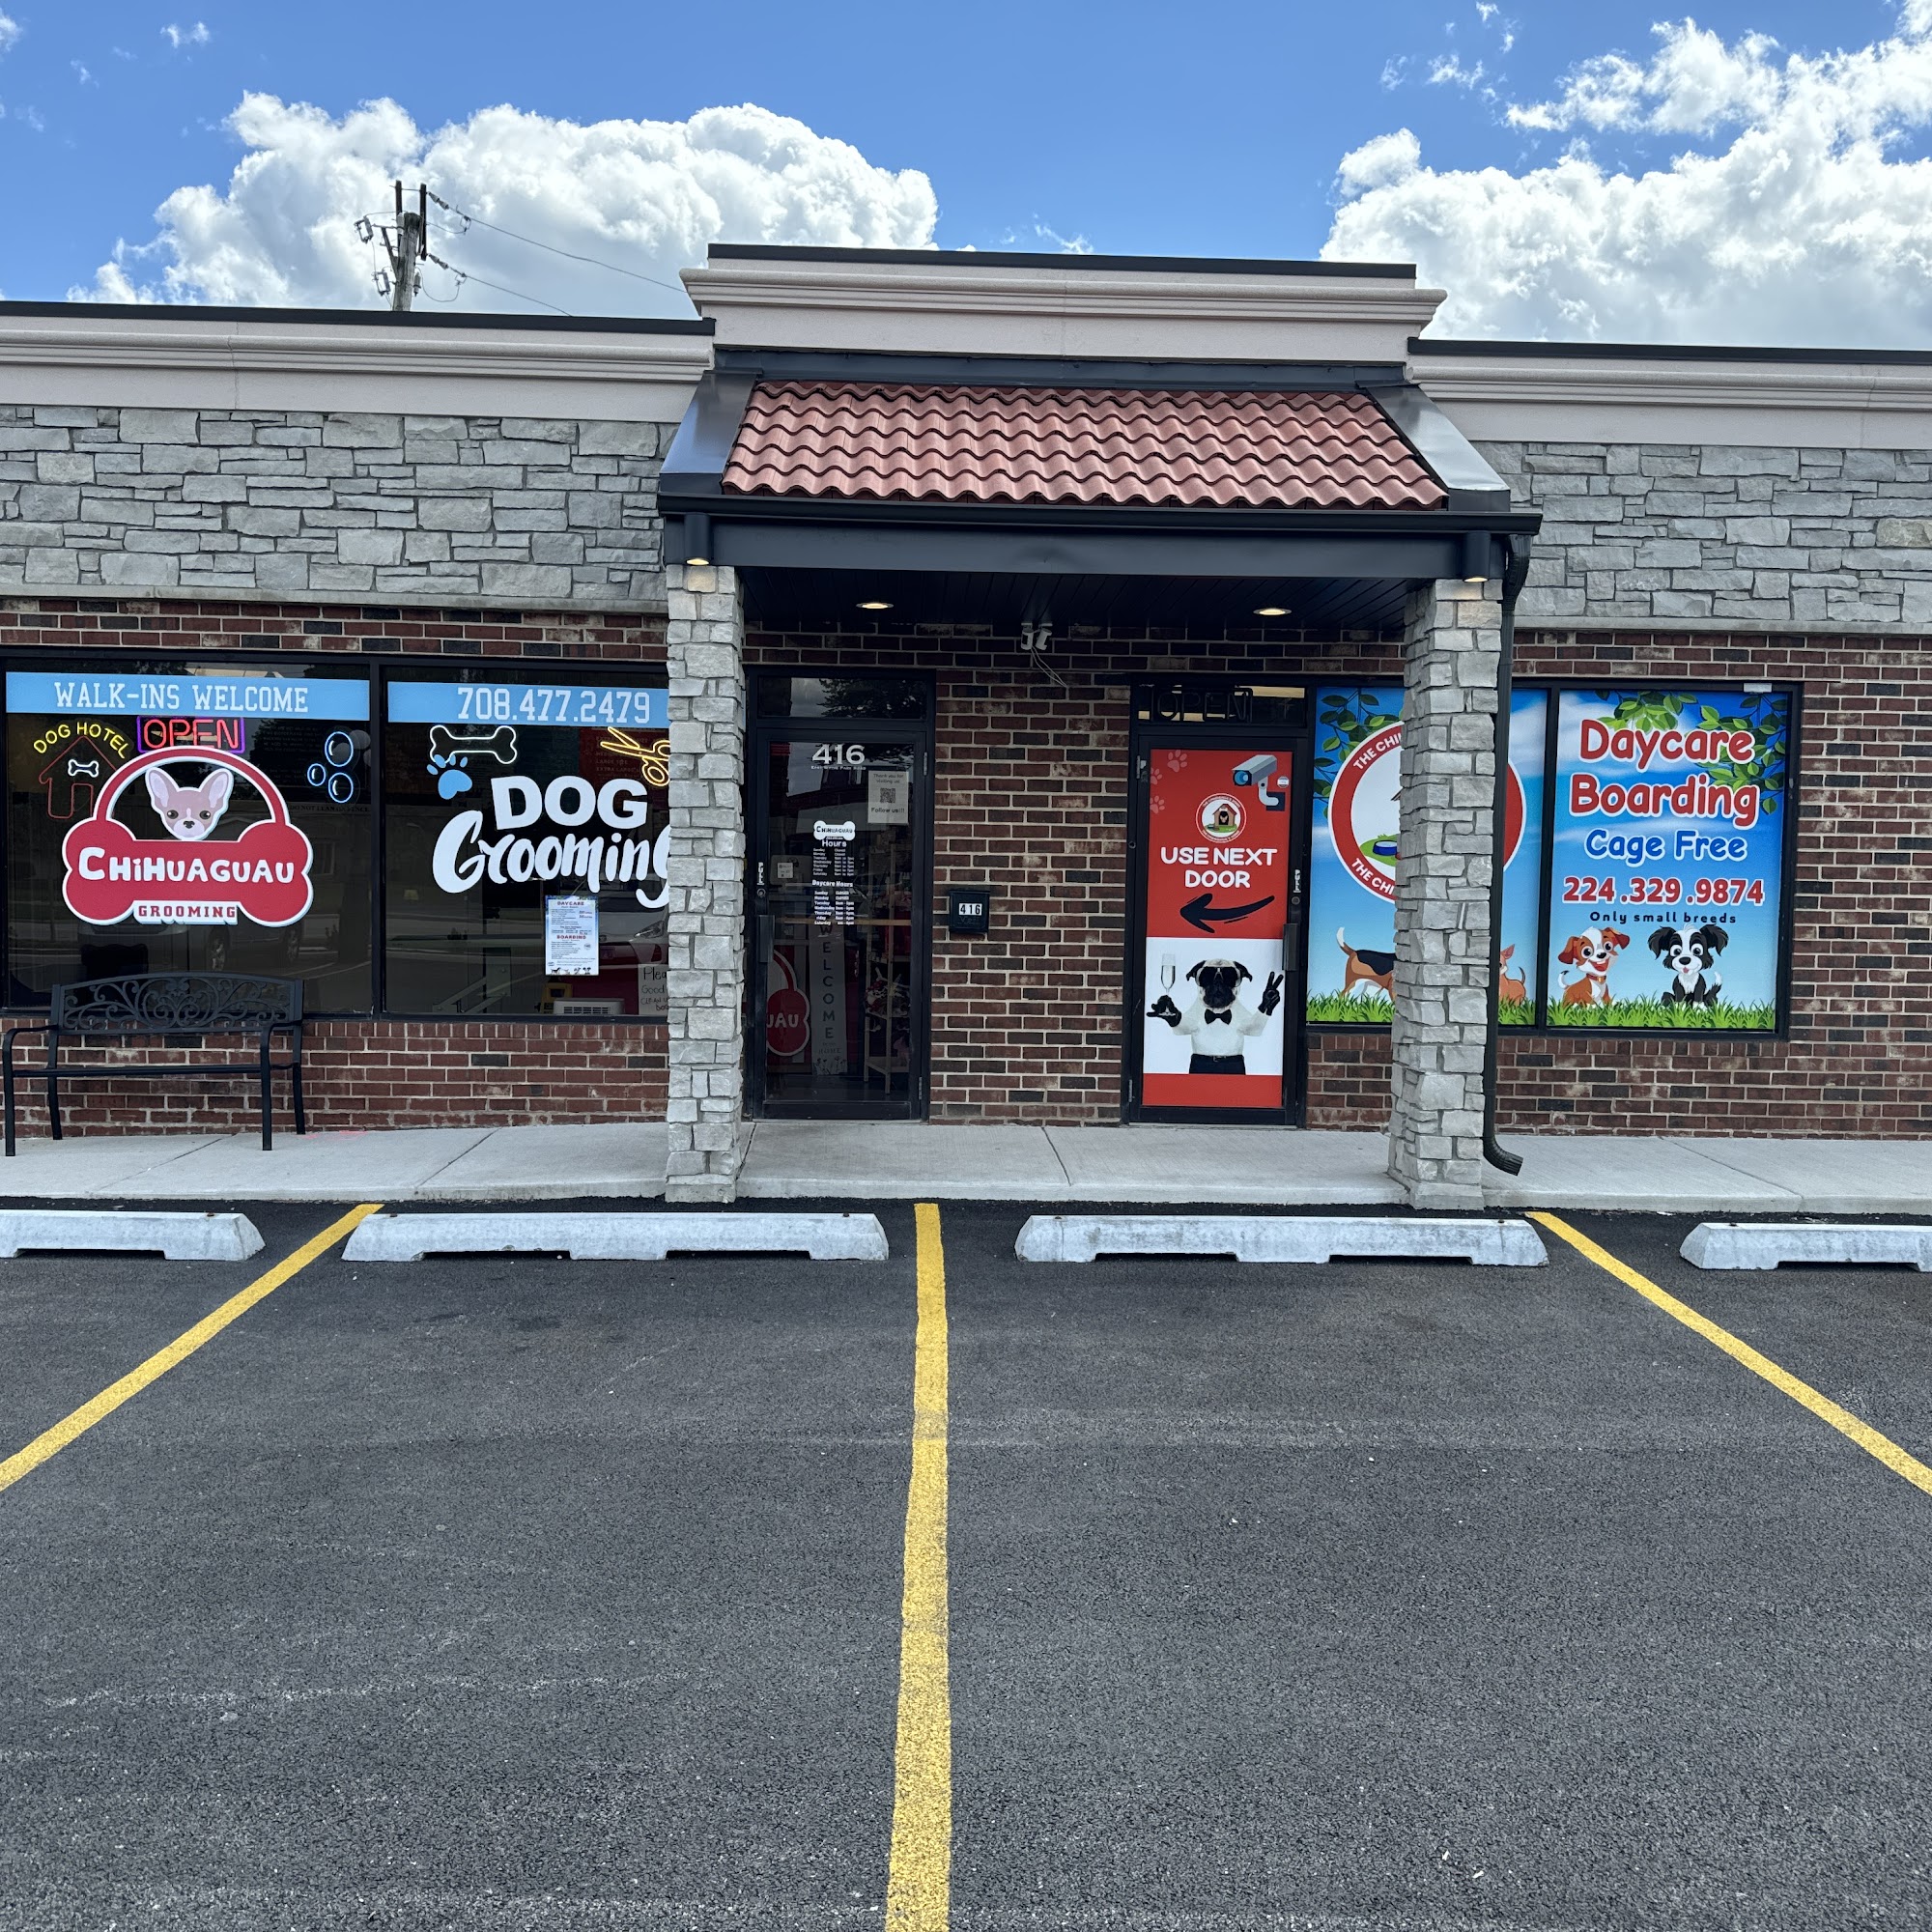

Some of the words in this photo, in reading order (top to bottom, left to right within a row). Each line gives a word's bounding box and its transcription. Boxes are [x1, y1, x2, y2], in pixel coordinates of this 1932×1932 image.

[55, 682, 180, 710] WALK-INS
[192, 684, 309, 712] WELCOME
[457, 687, 650, 724] 708.477.2479
[34, 724, 71, 753] DOG
[77, 722, 128, 758] HOTEL
[144, 719, 238, 749] OPEN
[1579, 720, 1753, 770] Daycare
[812, 744, 866, 765] 416
[1353, 748, 1377, 770] THE
[491, 776, 648, 830] DOG
[1571, 774, 1758, 826] Boarding
[821, 839, 847, 848] Hours
[1586, 829, 1662, 864] Cage
[1676, 831, 1746, 858] Free
[1160, 846, 1209, 865] USE
[1213, 847, 1278, 866] NEXT
[1184, 869, 1251, 888] DOOR
[1351, 858, 1373, 881] THE
[138, 905, 237, 919] GROOMING
[960, 904, 980, 915] 416
[1589, 911, 1627, 924] Only
[1634, 911, 1677, 923] small
[1684, 912, 1736, 923] breeds
[641, 984, 666, 994] Good
[819, 924, 836, 1039] WELCOME
